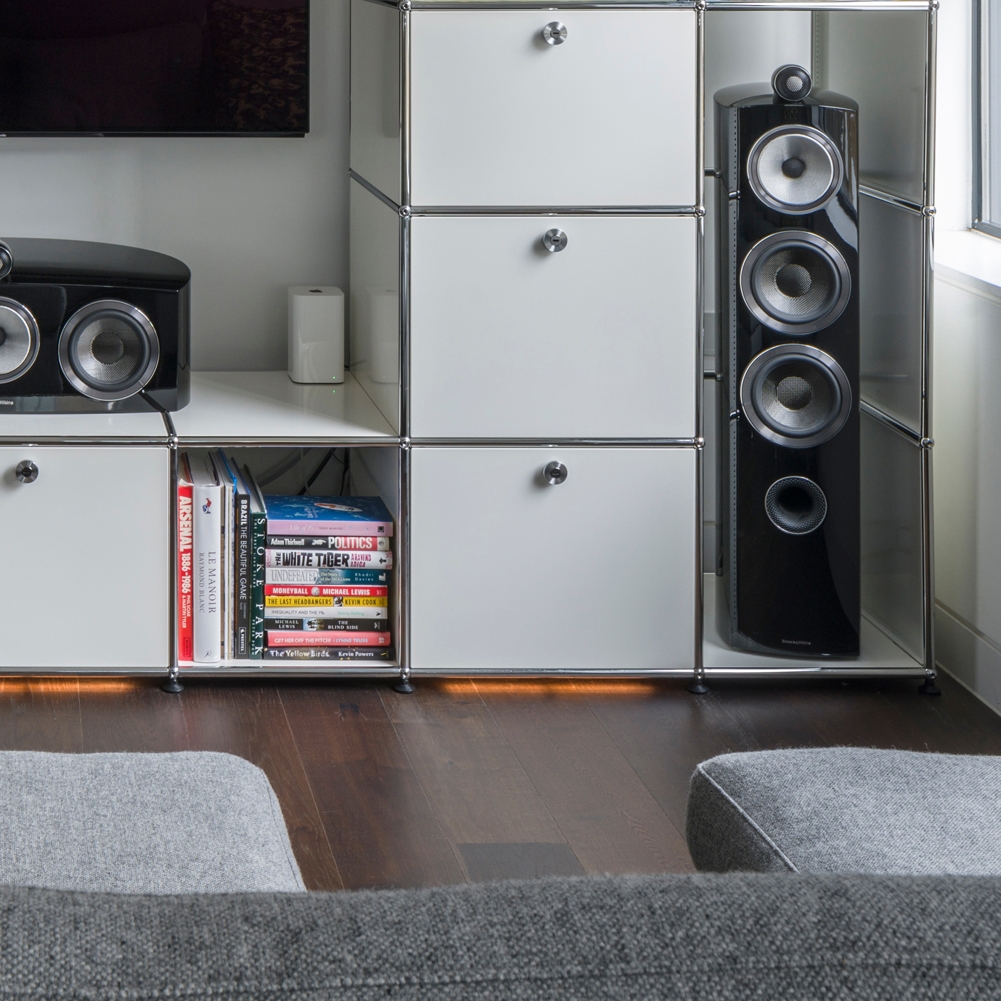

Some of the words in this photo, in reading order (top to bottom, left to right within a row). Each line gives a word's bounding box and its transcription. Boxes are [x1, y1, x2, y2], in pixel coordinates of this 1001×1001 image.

[179, 496, 192, 552] ARSENAL
[328, 536, 372, 549] POLITICS
[182, 552, 191, 593] 1886-1986
[208, 552, 216, 565] LE
[208, 568, 216, 614] MANOIR
